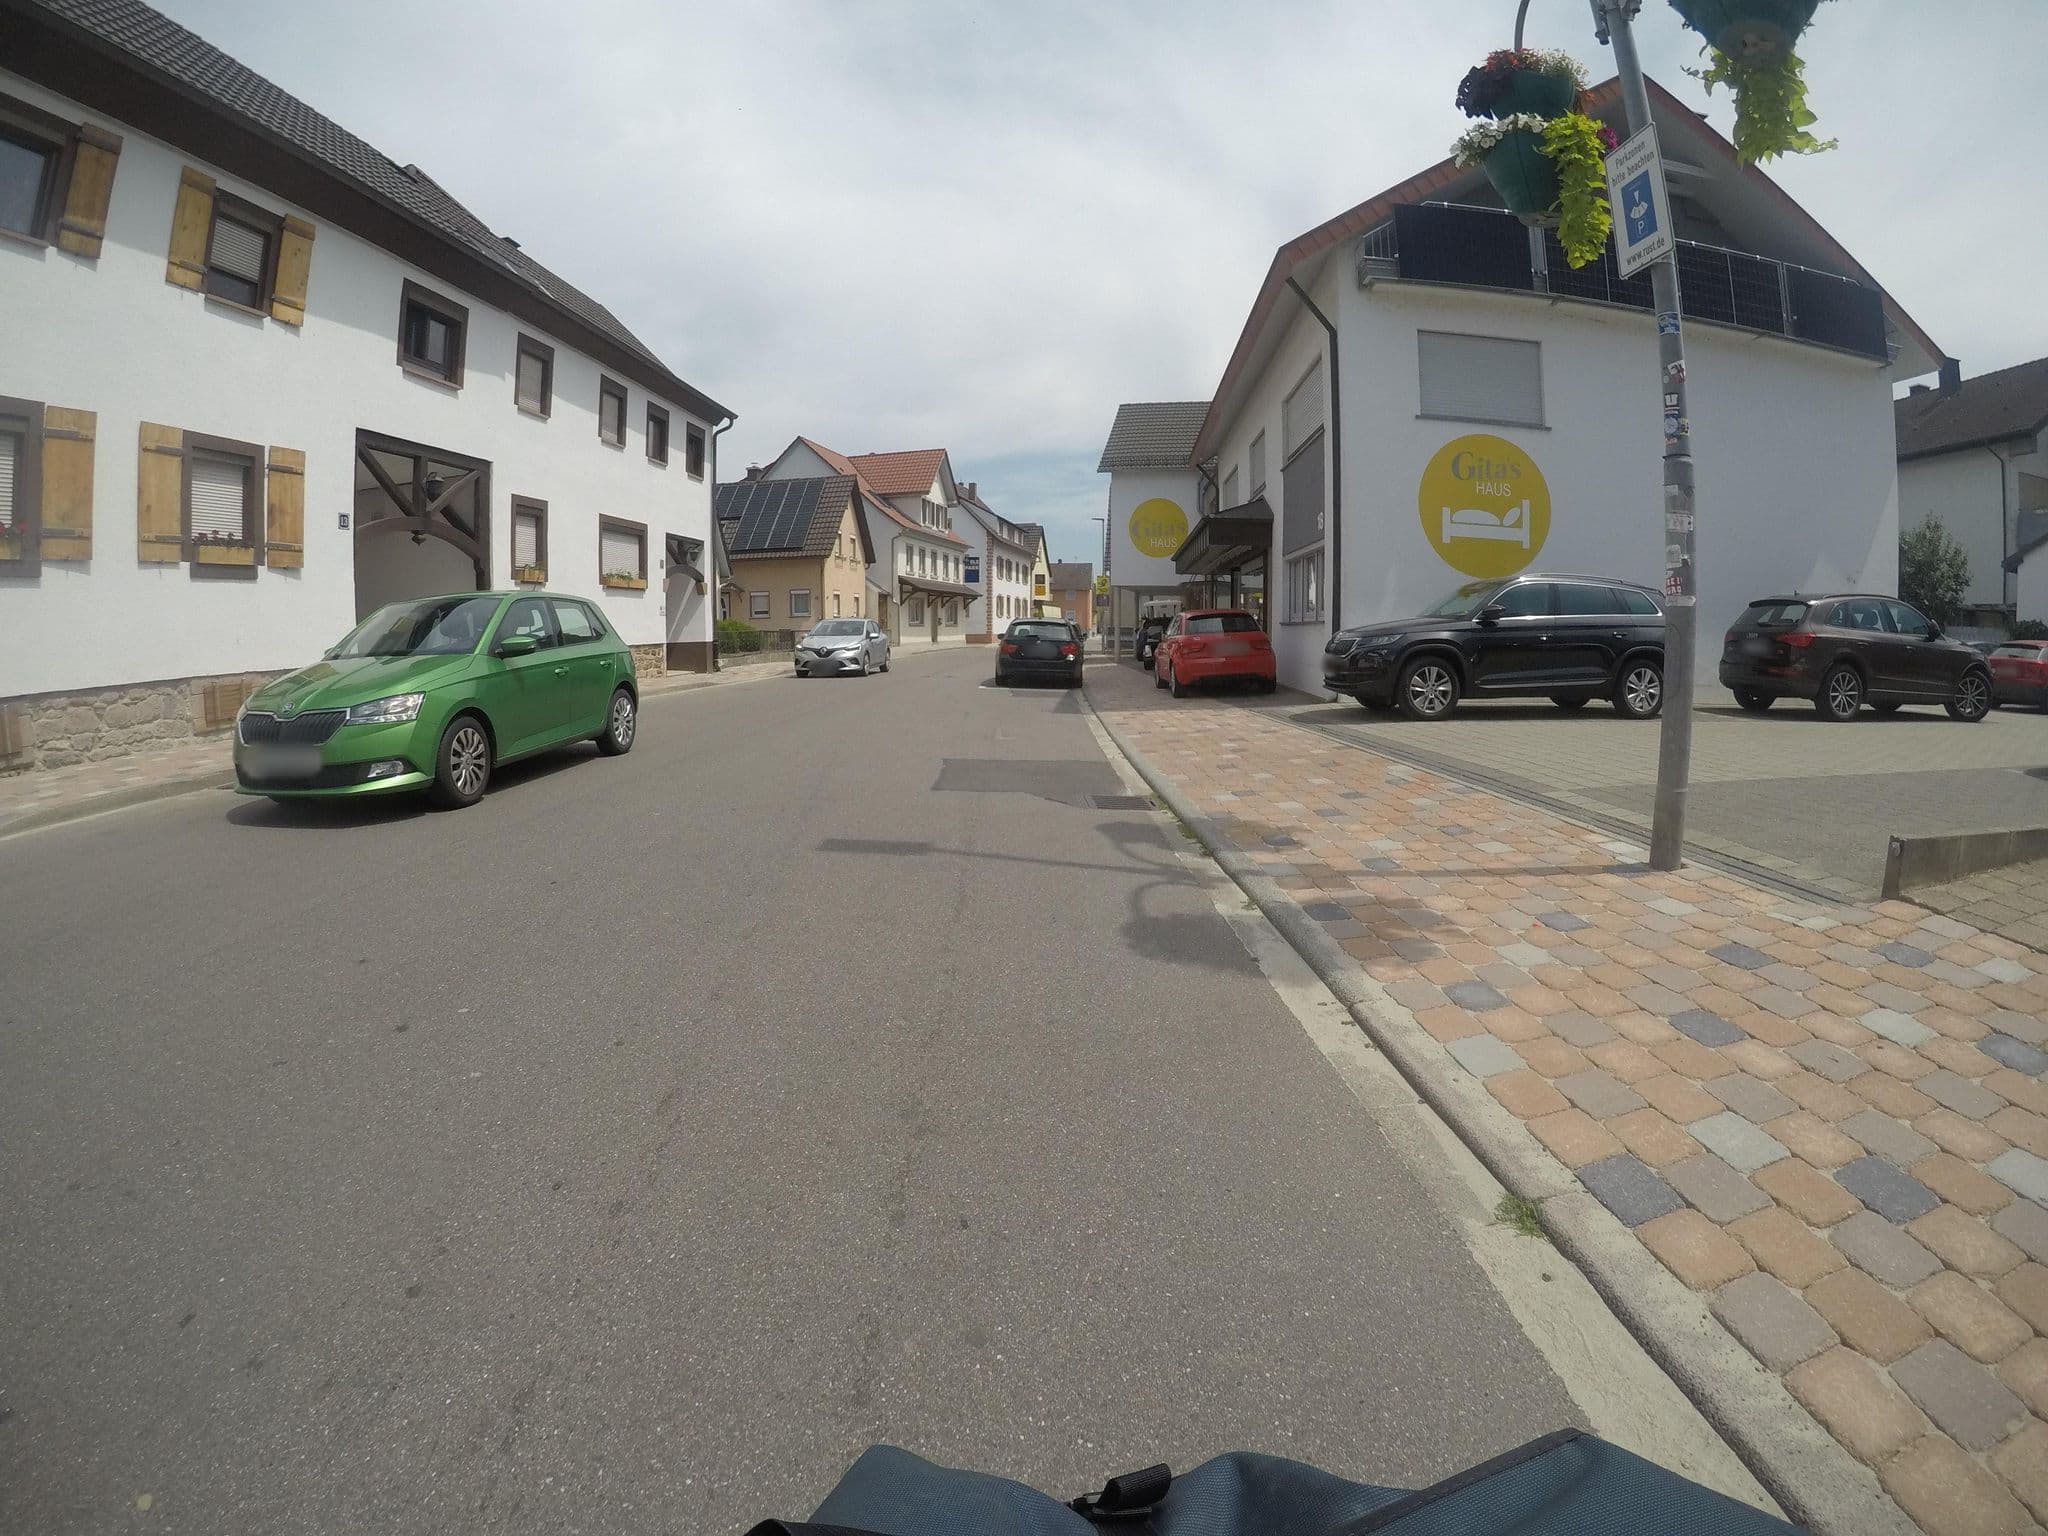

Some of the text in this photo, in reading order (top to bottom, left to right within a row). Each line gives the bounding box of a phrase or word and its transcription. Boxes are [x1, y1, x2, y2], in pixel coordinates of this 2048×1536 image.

[1611, 171, 1626, 187] bitte
[1627, 151, 1655, 177] beachten
[1615, 140, 1646, 169] Parkzonen
[1626, 236, 1665, 266] www.rust.de
[1451, 451, 1522, 480] Gita's
[1476, 481, 1512, 497] HAUS
[1150, 537, 1178, 548] HAUS
